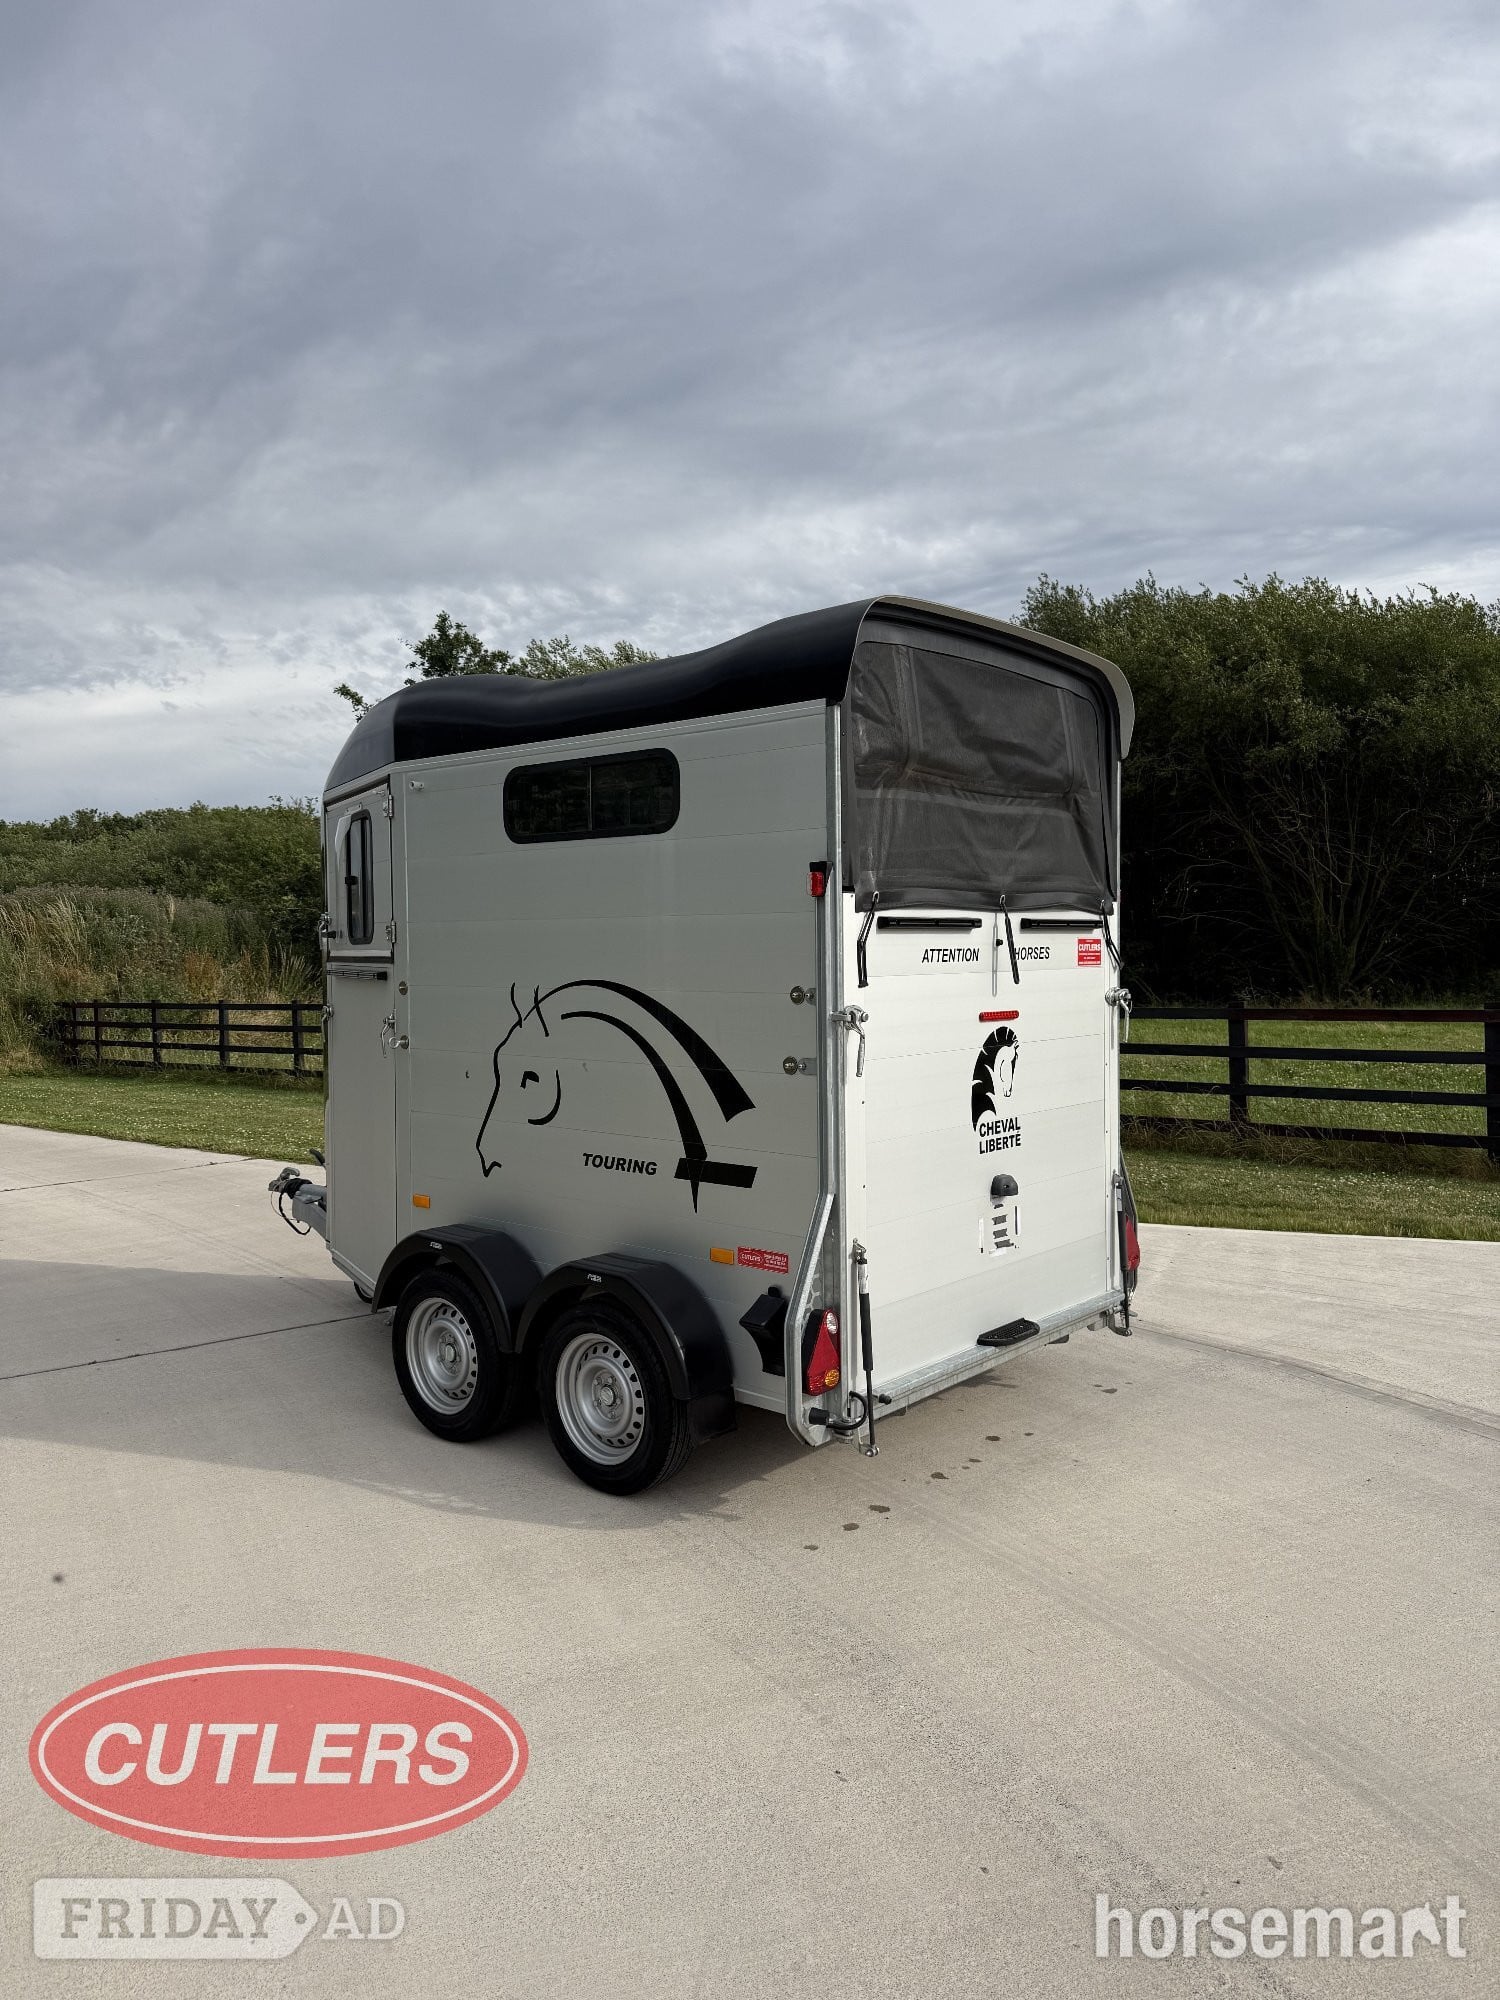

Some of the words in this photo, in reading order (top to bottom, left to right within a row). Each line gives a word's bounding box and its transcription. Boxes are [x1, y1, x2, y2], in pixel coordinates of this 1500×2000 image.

[922, 948, 979, 963] ATTENTION
[979, 1116, 1021, 1137] CHEVAL
[979, 1131, 1021, 1154] LIBERTÉ
[583, 1152, 657, 1175] TOURING
